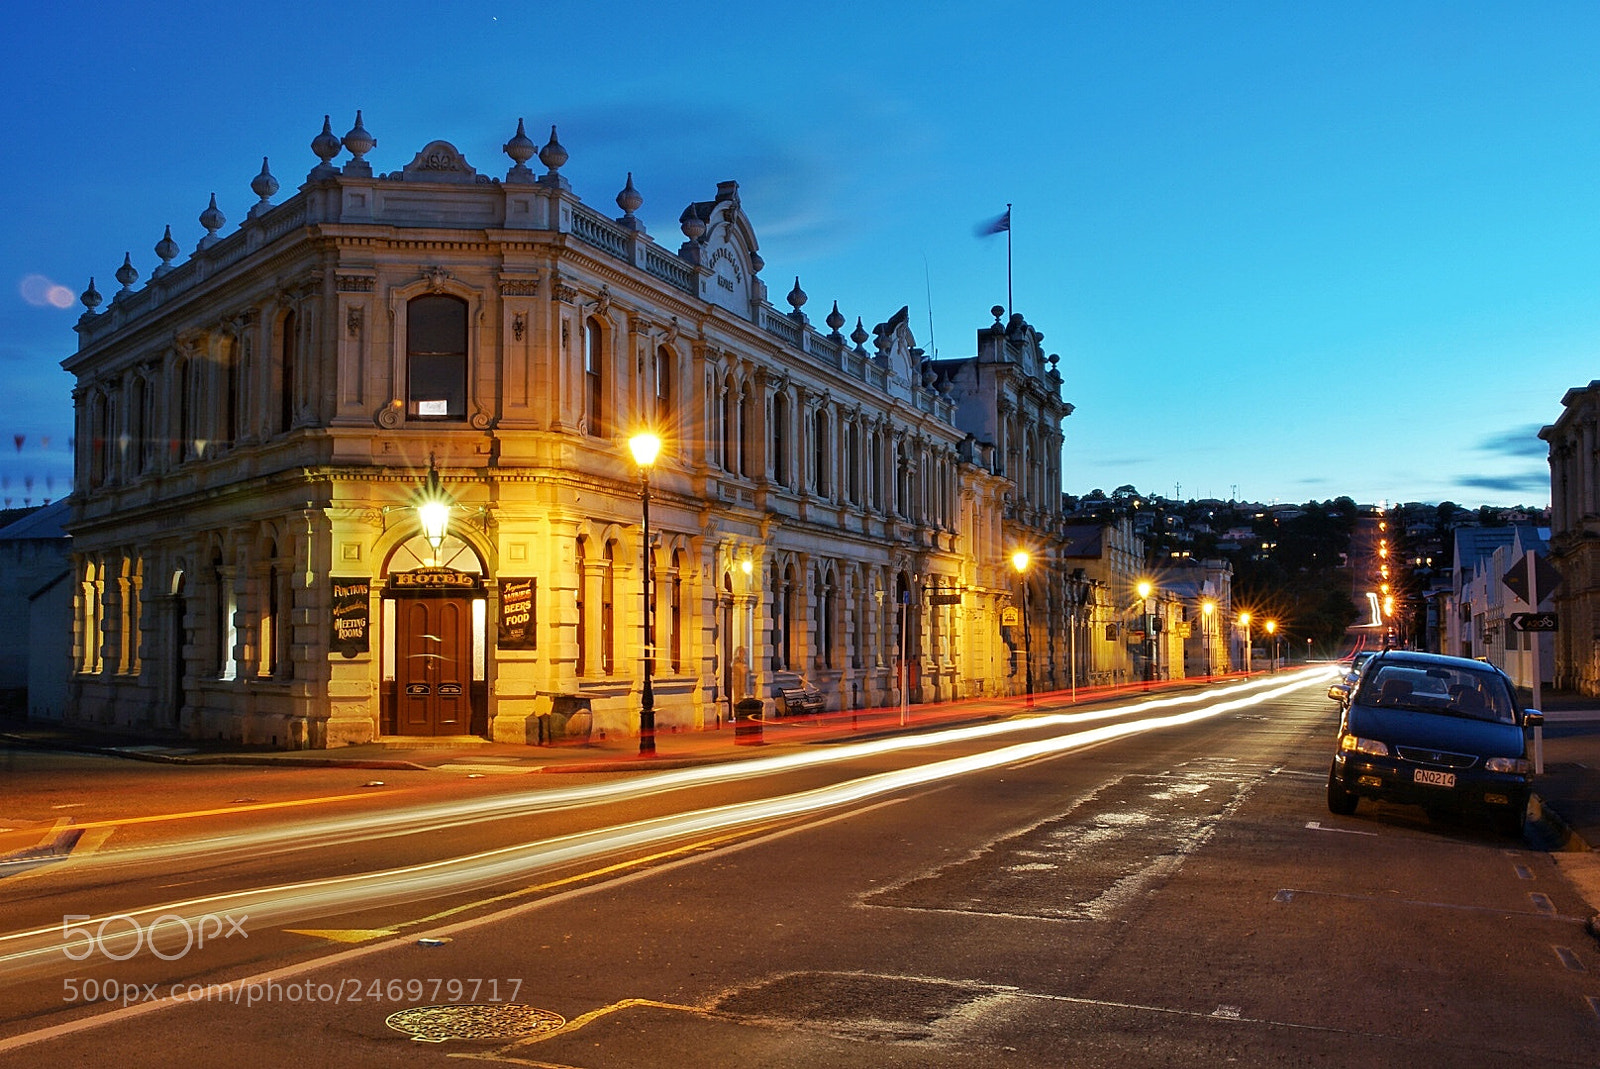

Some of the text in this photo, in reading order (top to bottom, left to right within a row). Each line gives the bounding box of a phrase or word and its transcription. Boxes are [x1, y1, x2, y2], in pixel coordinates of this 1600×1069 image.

[395, 573, 474, 587] HOTEL
[504, 589, 532, 603] WINES
[504, 600, 532, 615] BEERS
[334, 617, 366, 631] MEETING
[506, 613, 530, 626] FOOD
[338, 627, 363, 640] ROOMS
